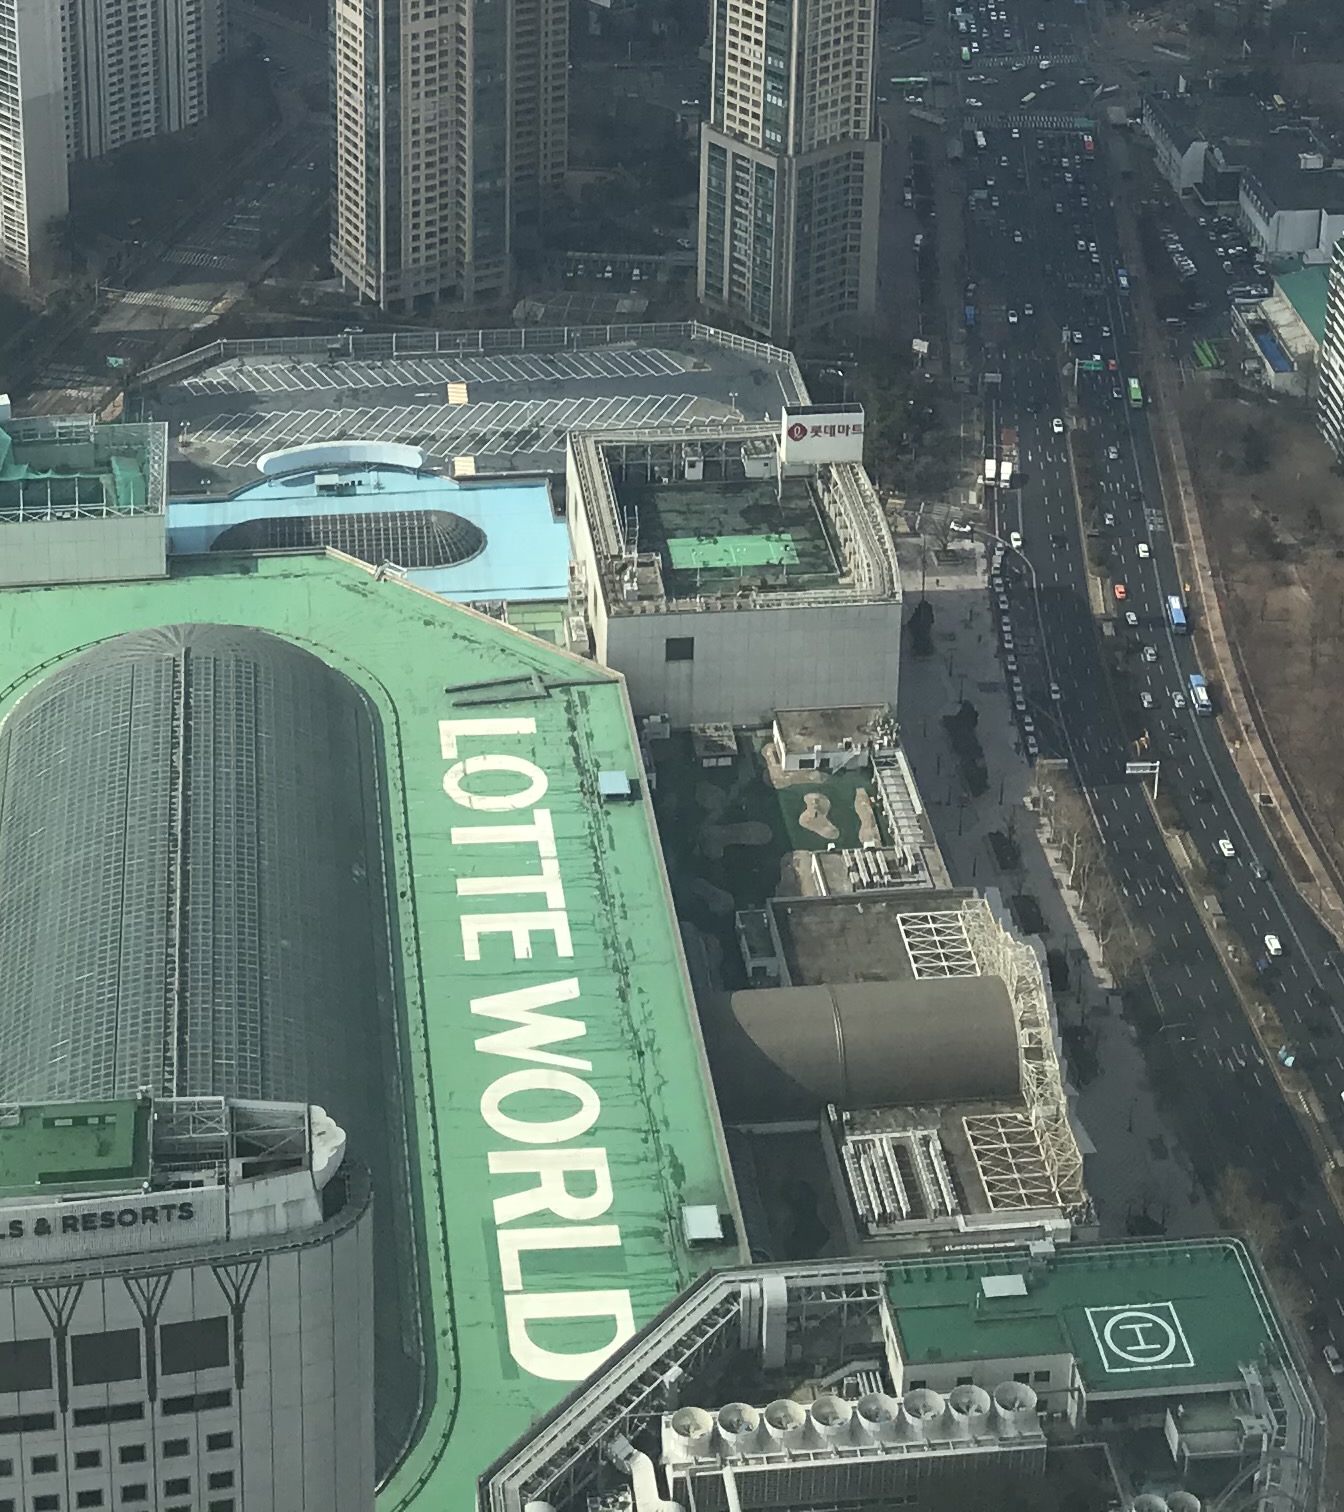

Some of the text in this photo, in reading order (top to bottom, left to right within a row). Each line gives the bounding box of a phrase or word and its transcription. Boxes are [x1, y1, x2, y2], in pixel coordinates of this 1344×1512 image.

[810, 424, 864, 438] 롯데마트
[438, 716, 637, 1381] LOTTE WORLD
[34, 1217, 53, 1236] &
[61, 1201, 195, 1234] RESORTS
